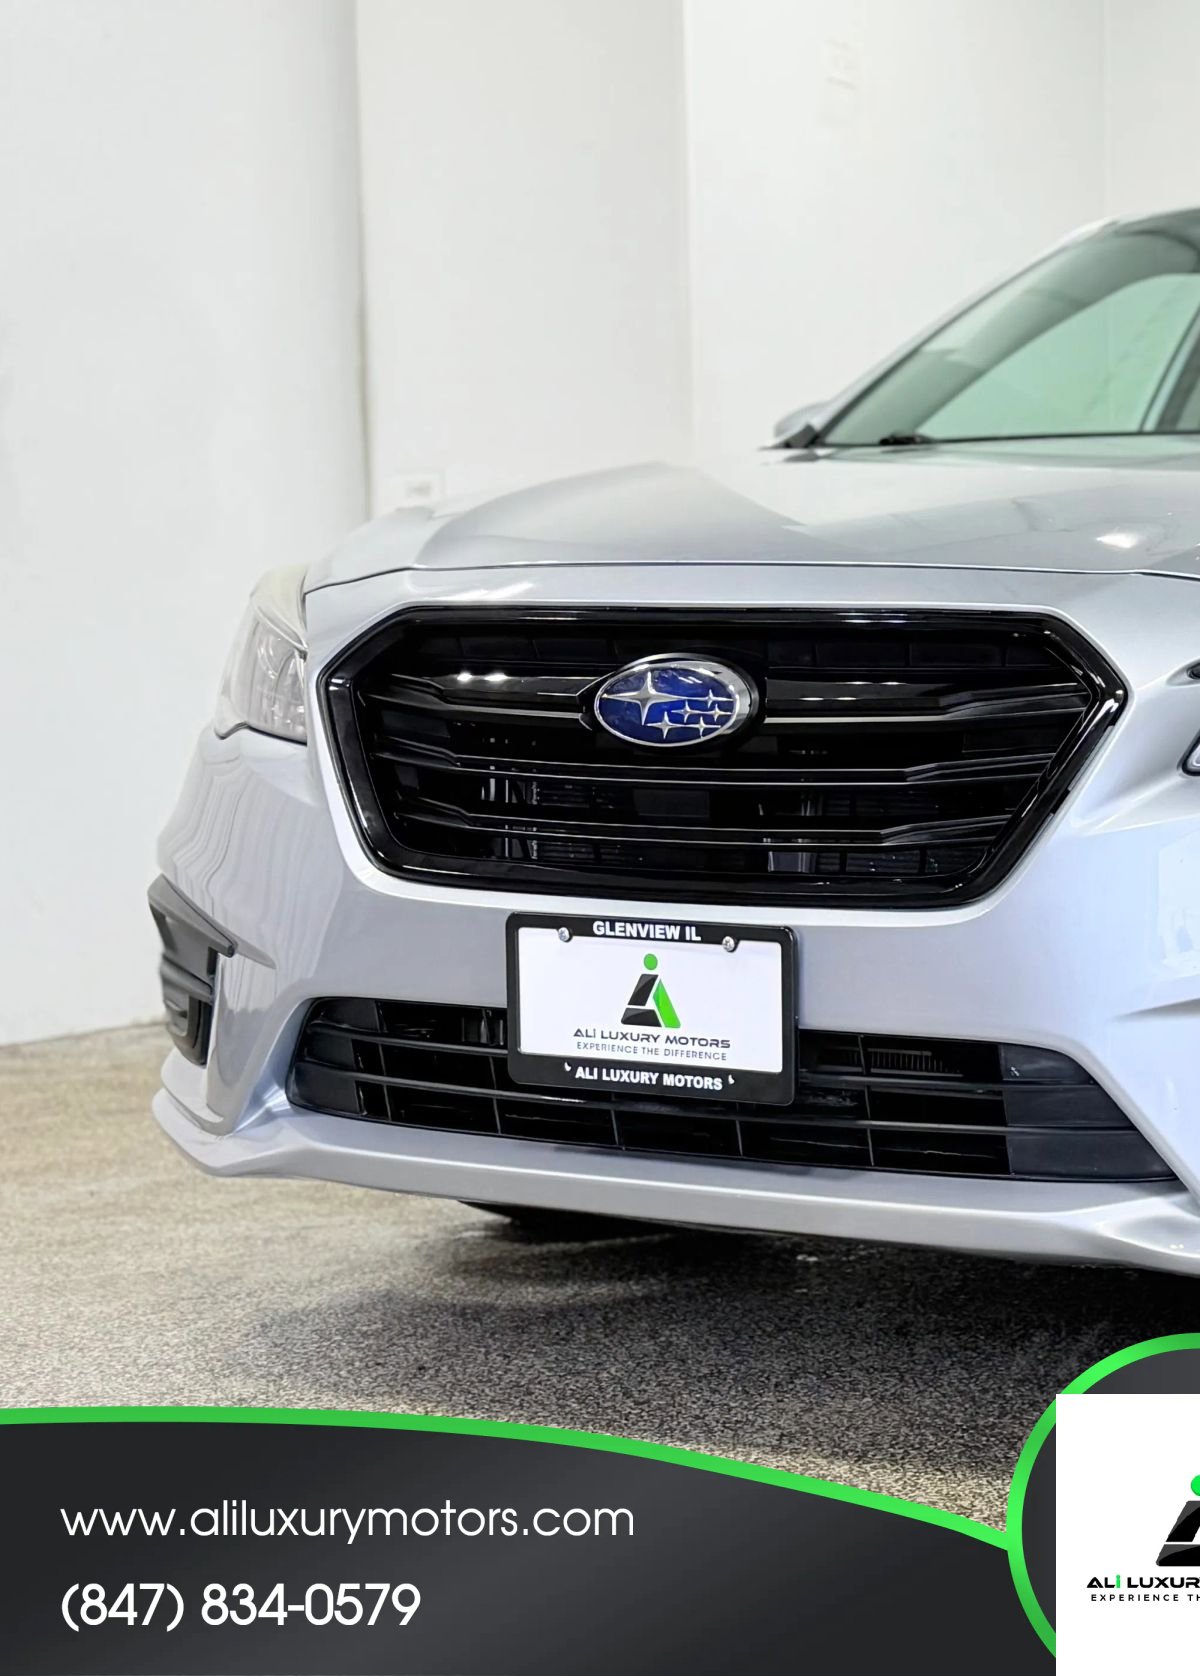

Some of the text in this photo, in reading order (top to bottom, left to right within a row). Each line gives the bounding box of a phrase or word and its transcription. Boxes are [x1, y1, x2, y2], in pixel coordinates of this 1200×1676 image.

[592, 920, 702, 942] GLENVIEW IL
[600, 1031, 661, 1045] LUXURY
[665, 1035, 731, 1049] MOTORS
[576, 1041, 728, 1061] EXPERIENCE THE DIFFERENCE
[575, 1066, 723, 1090] ALI LUXURY MOTORS
